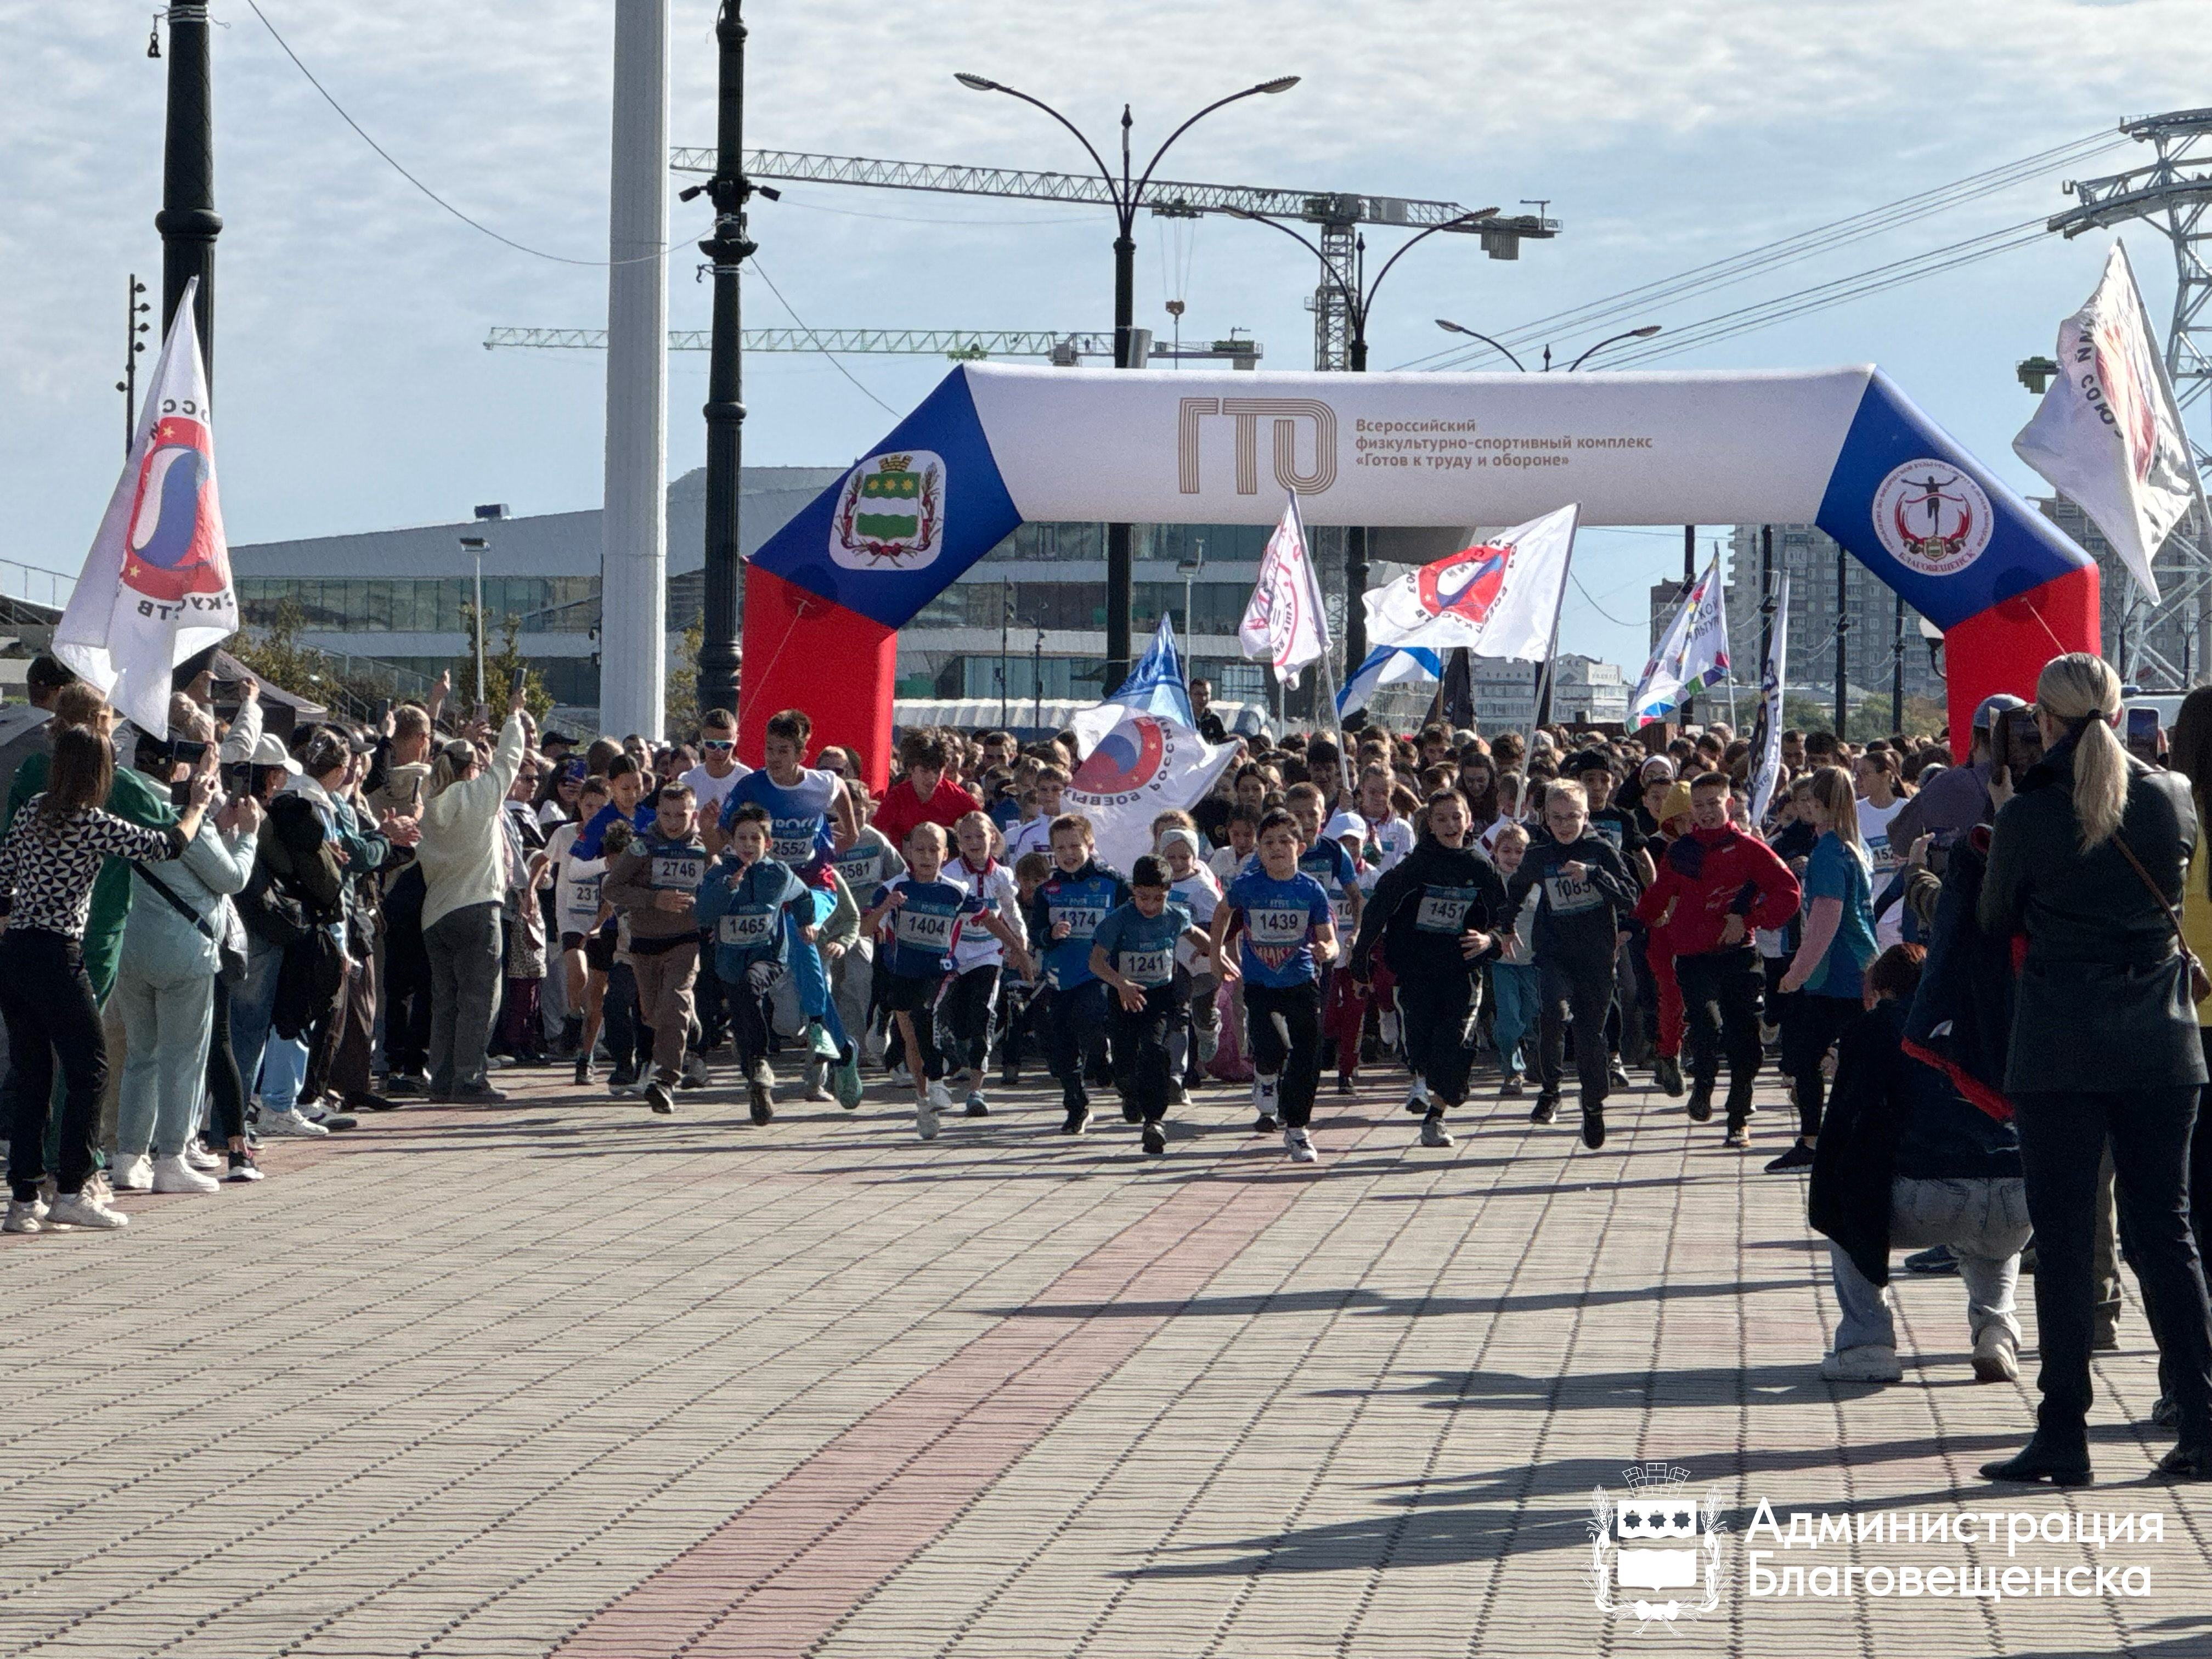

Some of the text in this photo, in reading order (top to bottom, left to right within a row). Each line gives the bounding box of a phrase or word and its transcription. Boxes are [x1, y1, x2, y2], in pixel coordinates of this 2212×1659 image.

[1356, 419, 1476, 434] Всероссийский
[1179, 398, 1337, 494] ГТО
[1356, 436, 1653, 451] физкультурно-спортивный комплекс
[1356, 453, 1569, 470] «Готов к труду и обороне»
[772, 841, 806, 856] 2552
[663, 861, 696, 878] 2746
[838, 861, 870, 879] 2581
[1431, 902, 1465, 920] 1451
[730, 917, 766, 934] 1465
[909, 916, 945, 936] 1404
[1260, 913, 1298, 930] 1439
[1128, 955, 1163, 972] 1241
